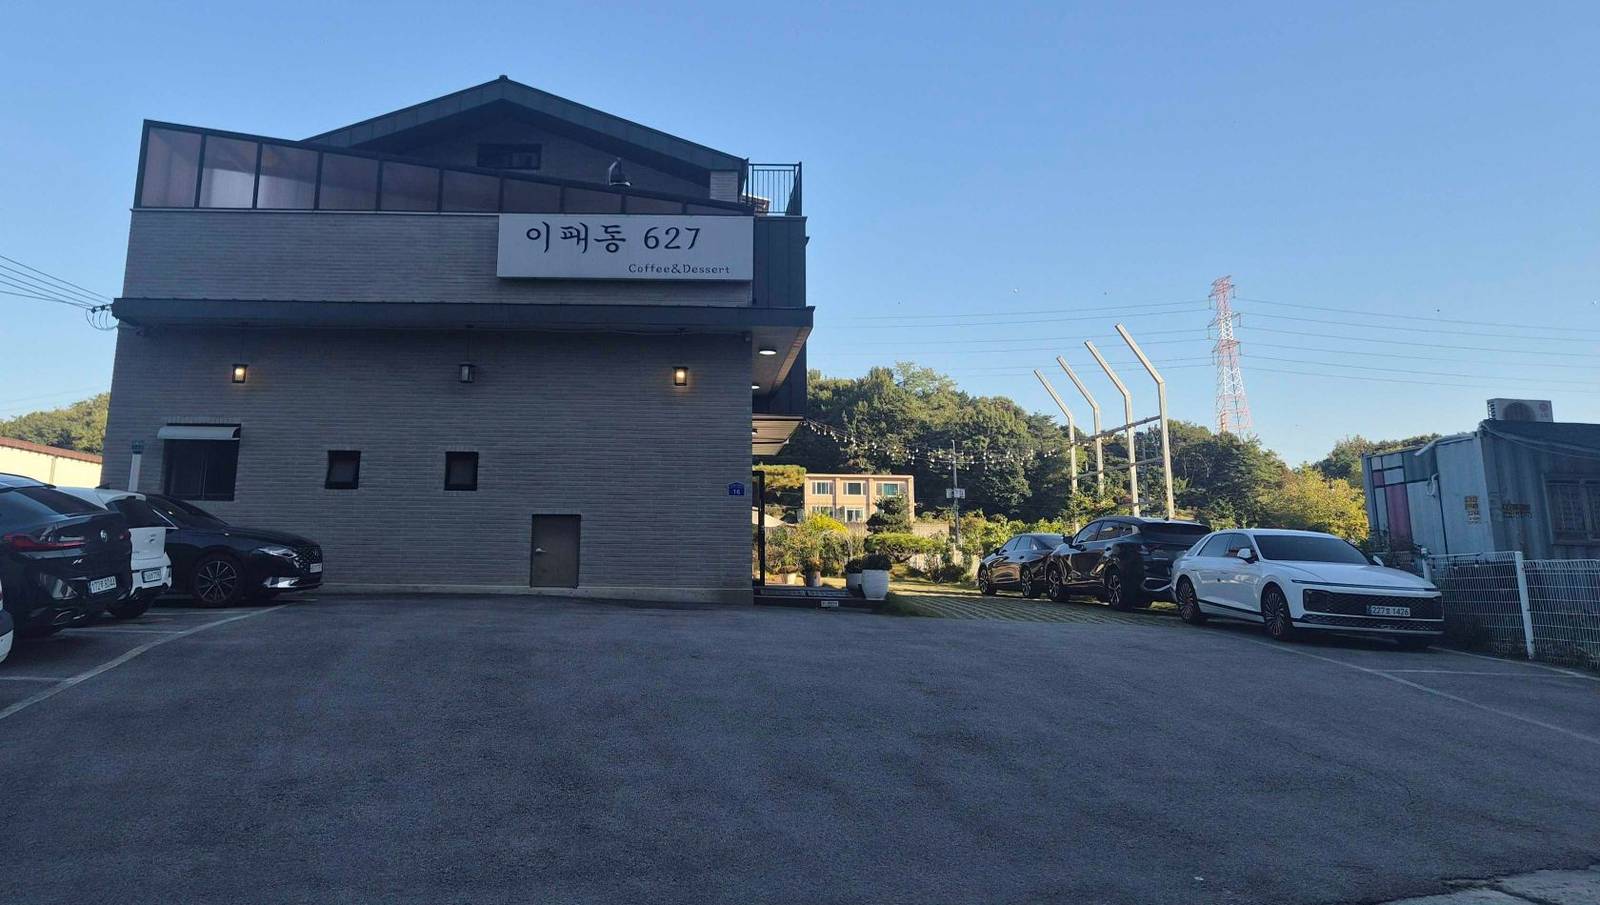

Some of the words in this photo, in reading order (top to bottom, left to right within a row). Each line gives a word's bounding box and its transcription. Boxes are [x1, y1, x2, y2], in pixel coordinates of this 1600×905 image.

[526, 221, 626, 253] 이패동
[643, 226, 701, 250] 627
[628, 263, 730, 275] Coffee&Dessert
